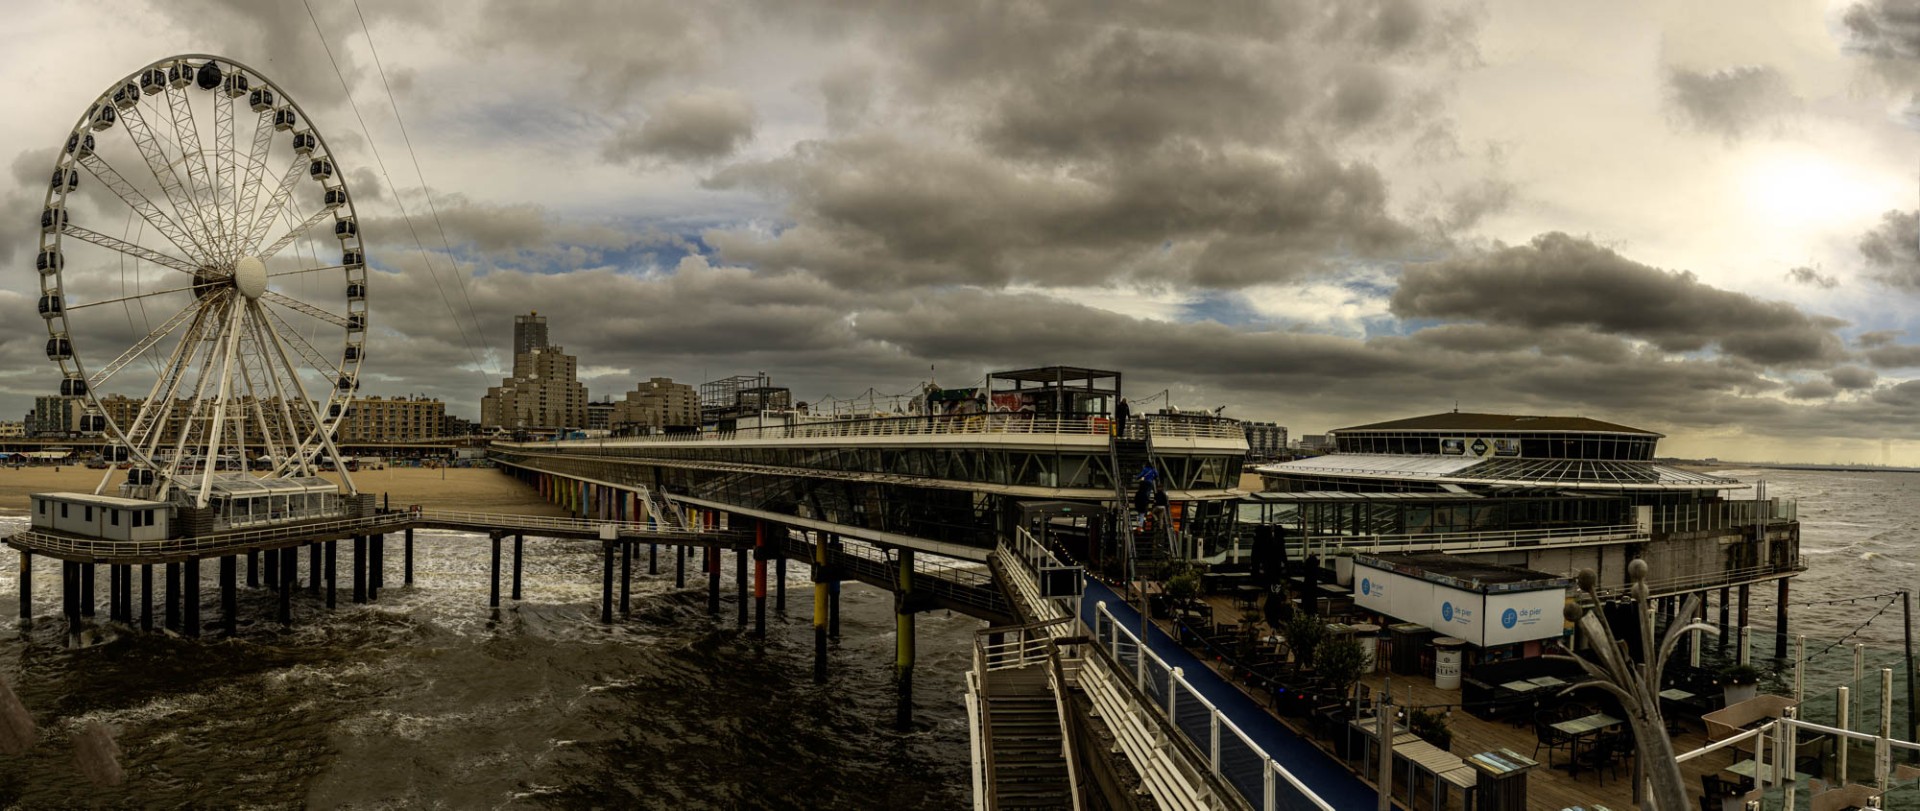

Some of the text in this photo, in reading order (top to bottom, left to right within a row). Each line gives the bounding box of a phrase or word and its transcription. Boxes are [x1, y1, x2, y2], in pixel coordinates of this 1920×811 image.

[1461, 608, 1472, 618] pier
[1519, 607, 1542, 618] de pier
